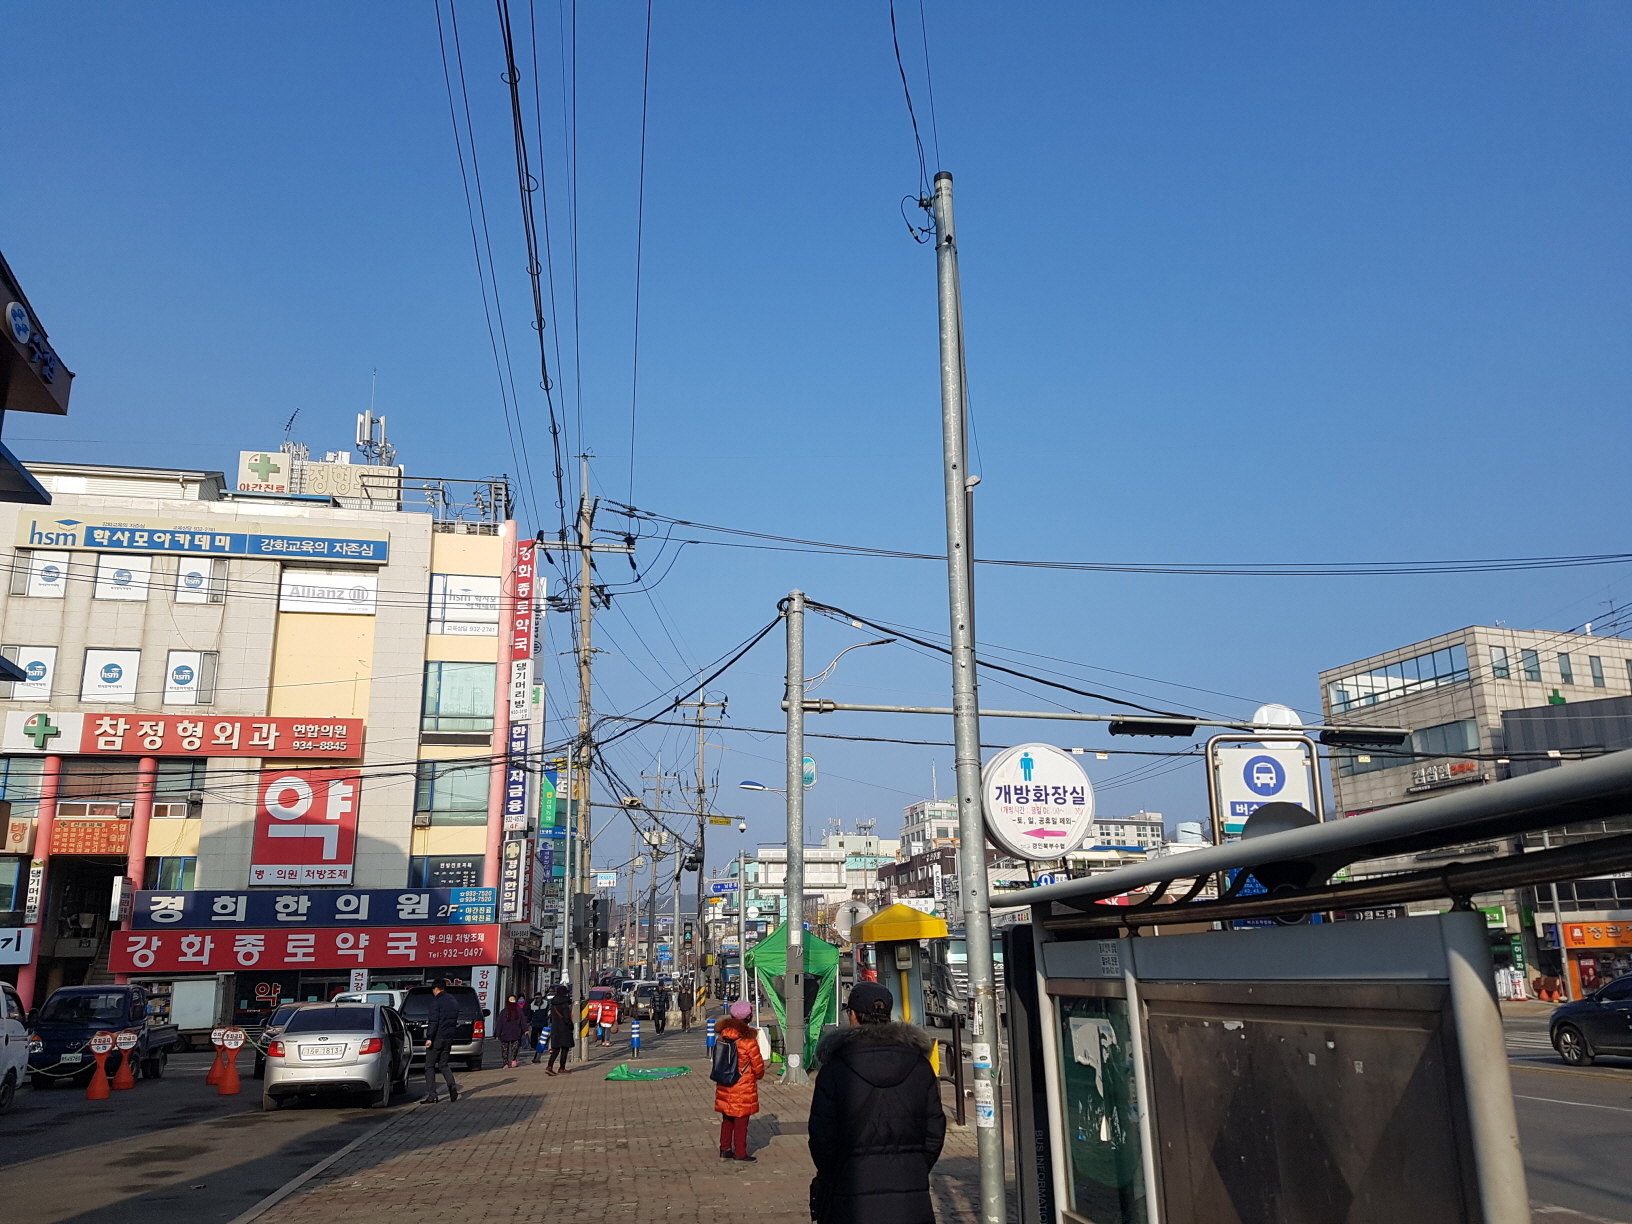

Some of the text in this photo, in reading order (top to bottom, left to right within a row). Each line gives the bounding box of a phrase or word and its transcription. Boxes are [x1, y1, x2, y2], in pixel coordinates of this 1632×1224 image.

[239, 483, 285, 493] 야간진료
[29, 520, 77, 546] hsm
[93, 529, 231, 551] 학사모아카데미
[261, 538, 375, 556] 강화교육의 자존심
[114, 571, 130, 581] hsm
[290, 586, 345, 600] Allianz
[514, 546, 533, 652] 강화종로약국
[101, 669, 120, 679] hsm
[173, 670, 191, 680] hsm
[514, 662, 527, 709] 댕기머리방
[94, 716, 280, 751] 참정형외과
[293, 724, 347, 739] 연합의원
[293, 741, 347, 751] 934-8845
[995, 784, 1086, 806] 개방화장실
[264, 776, 354, 861] 약
[1039, 817, 1058, 825] 공휴일
[10, 822, 27, 843] 방
[305, 868, 348, 880] 처방조제
[26, 869, 41, 913] 댕기머리방
[503, 860, 518, 913] 경희한의원
[150, 893, 430, 923] 경희한의원
[437, 904, 460, 917] 2F
[456, 932, 485, 943] 처방조제
[126, 932, 418, 968] 강화종로약국
[255, 982, 282, 1007] 약
[1035, 1130, 1049, 1224] BUS INFORMATIO
